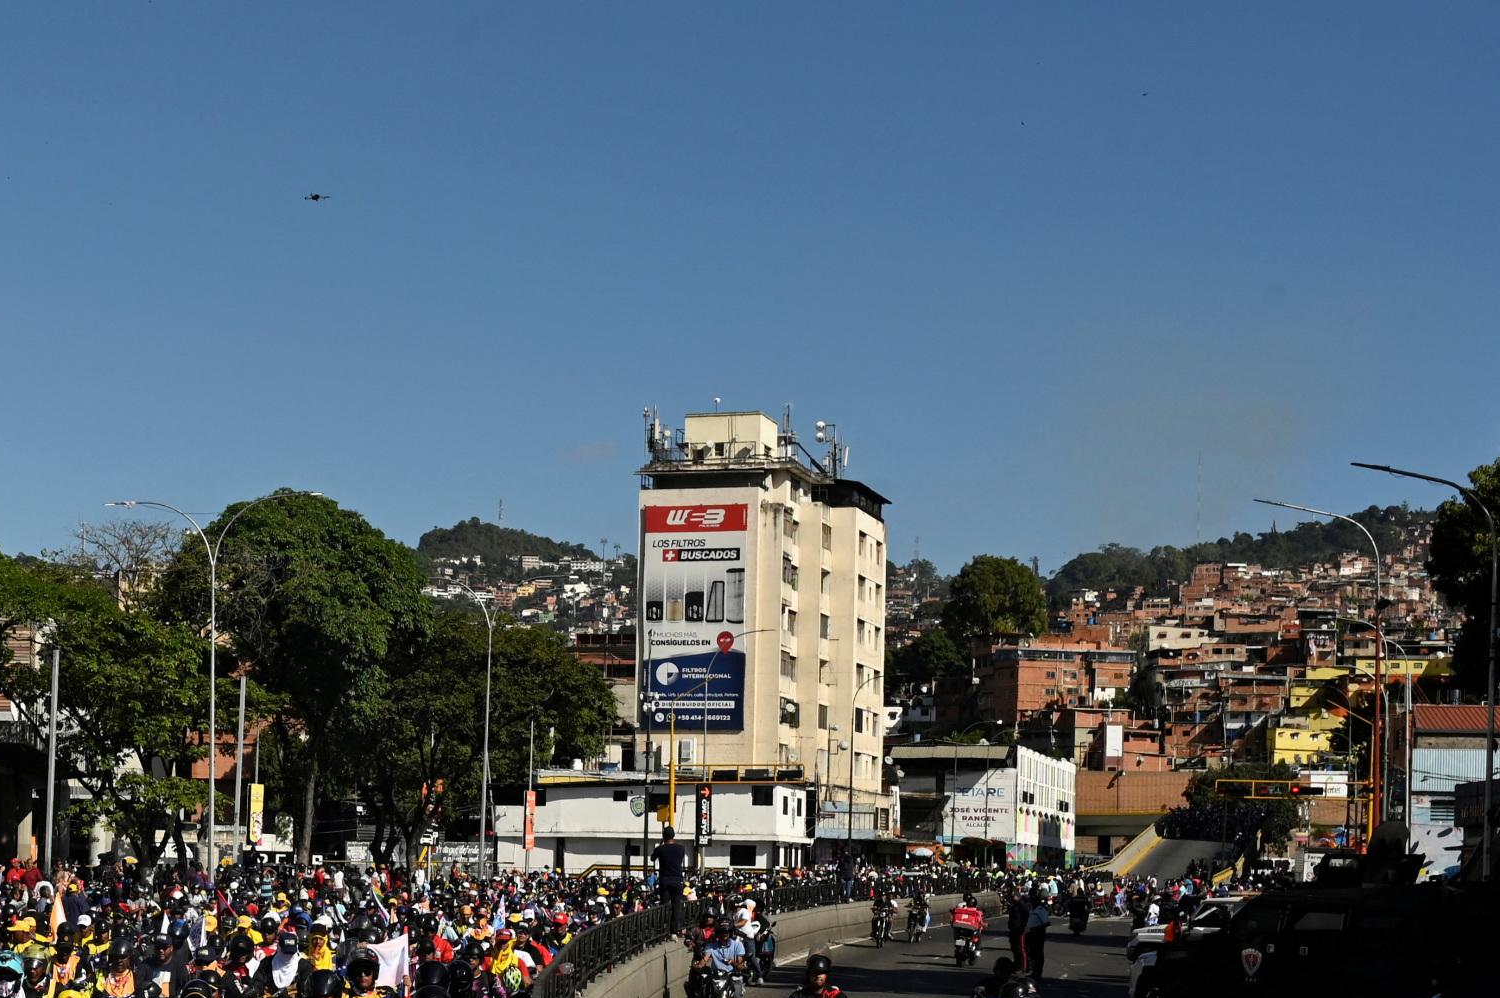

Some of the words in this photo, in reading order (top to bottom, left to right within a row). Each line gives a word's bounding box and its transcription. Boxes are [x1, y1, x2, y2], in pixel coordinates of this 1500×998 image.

[652, 539, 670, 548] LOS
[671, 538, 706, 547] FILTROS
[681, 550, 737, 560] BUSCADOS
[651, 638, 700, 646] CONSÍGUELOS
[949, 806, 970, 814] JOSÉ
